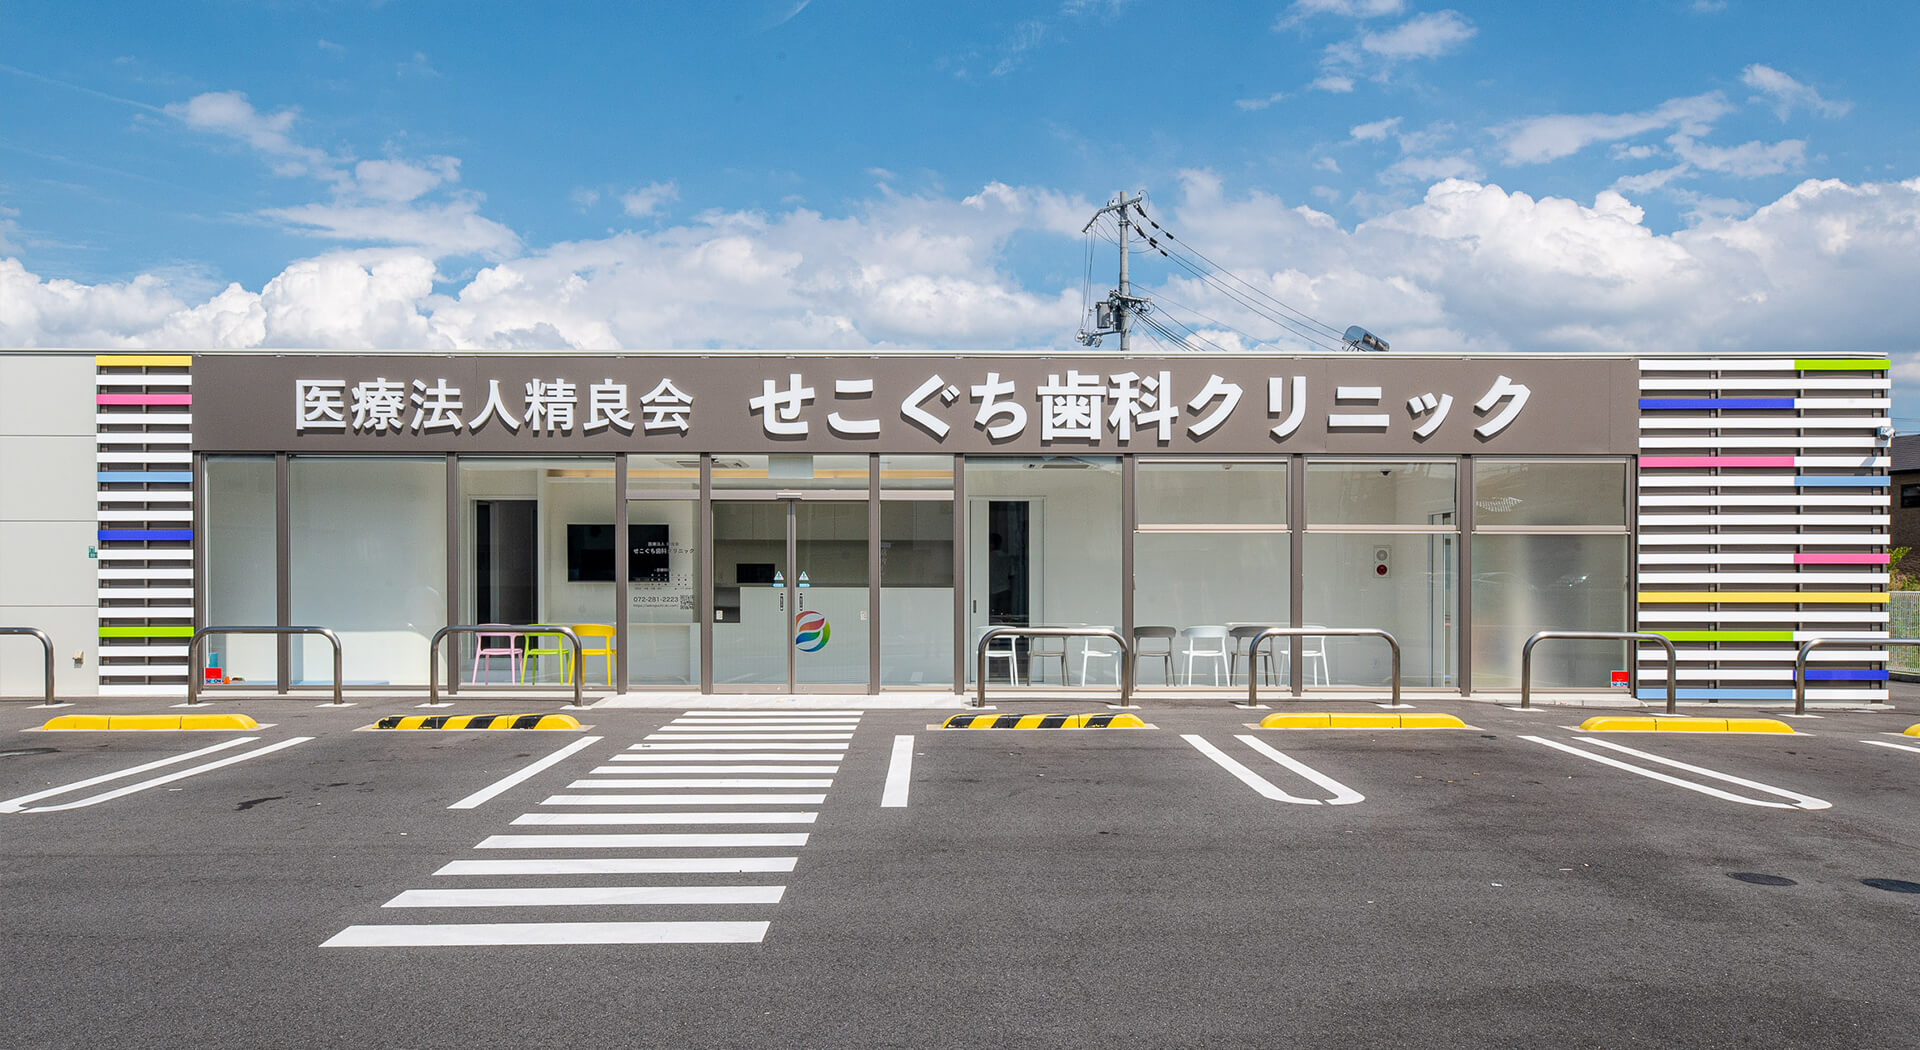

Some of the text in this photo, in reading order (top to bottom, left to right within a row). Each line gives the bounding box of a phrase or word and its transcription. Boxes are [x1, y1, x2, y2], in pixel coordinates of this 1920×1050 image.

[295, 371, 1531, 443] 医療法人精良会 せこぐち歯科クリニック
